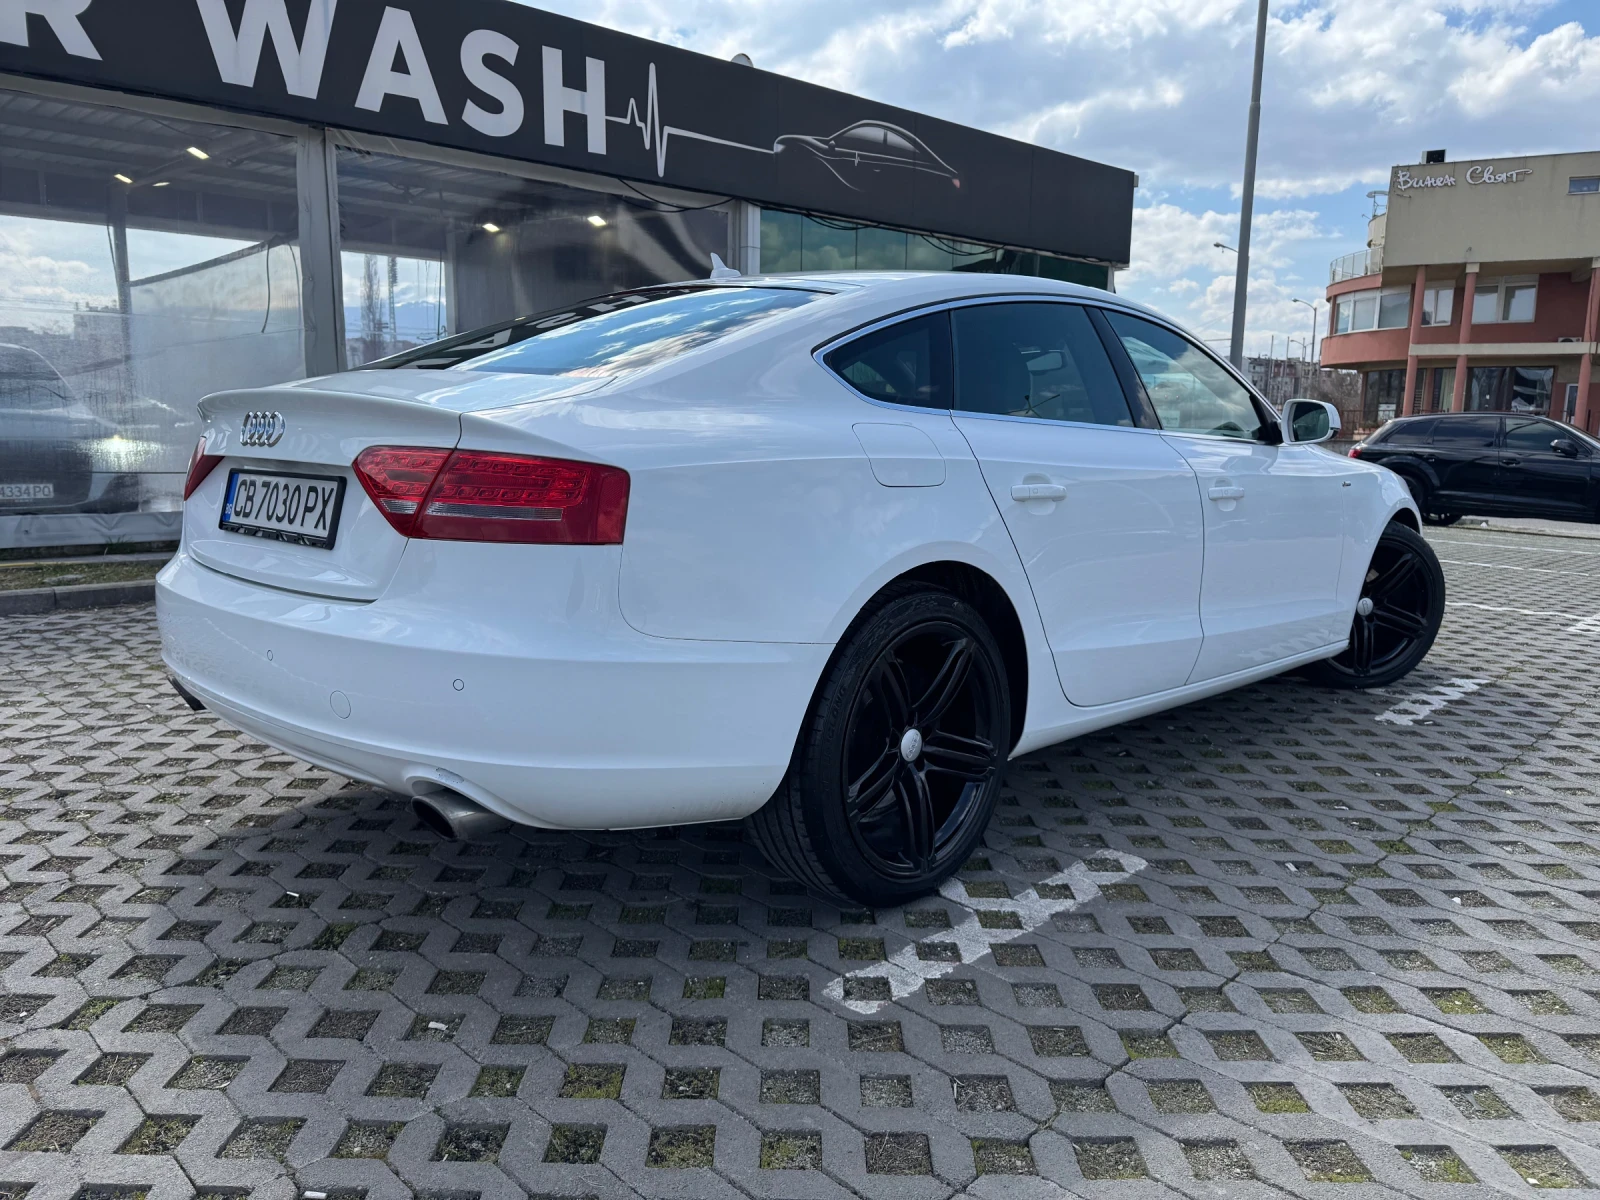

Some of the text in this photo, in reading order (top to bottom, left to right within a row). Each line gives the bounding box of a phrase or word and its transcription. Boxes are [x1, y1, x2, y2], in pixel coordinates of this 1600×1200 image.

[195, 0, 607, 155] WASH
[1398, 165, 1533, 191] Винен Свят
[255, 480, 301, 525] 7030
